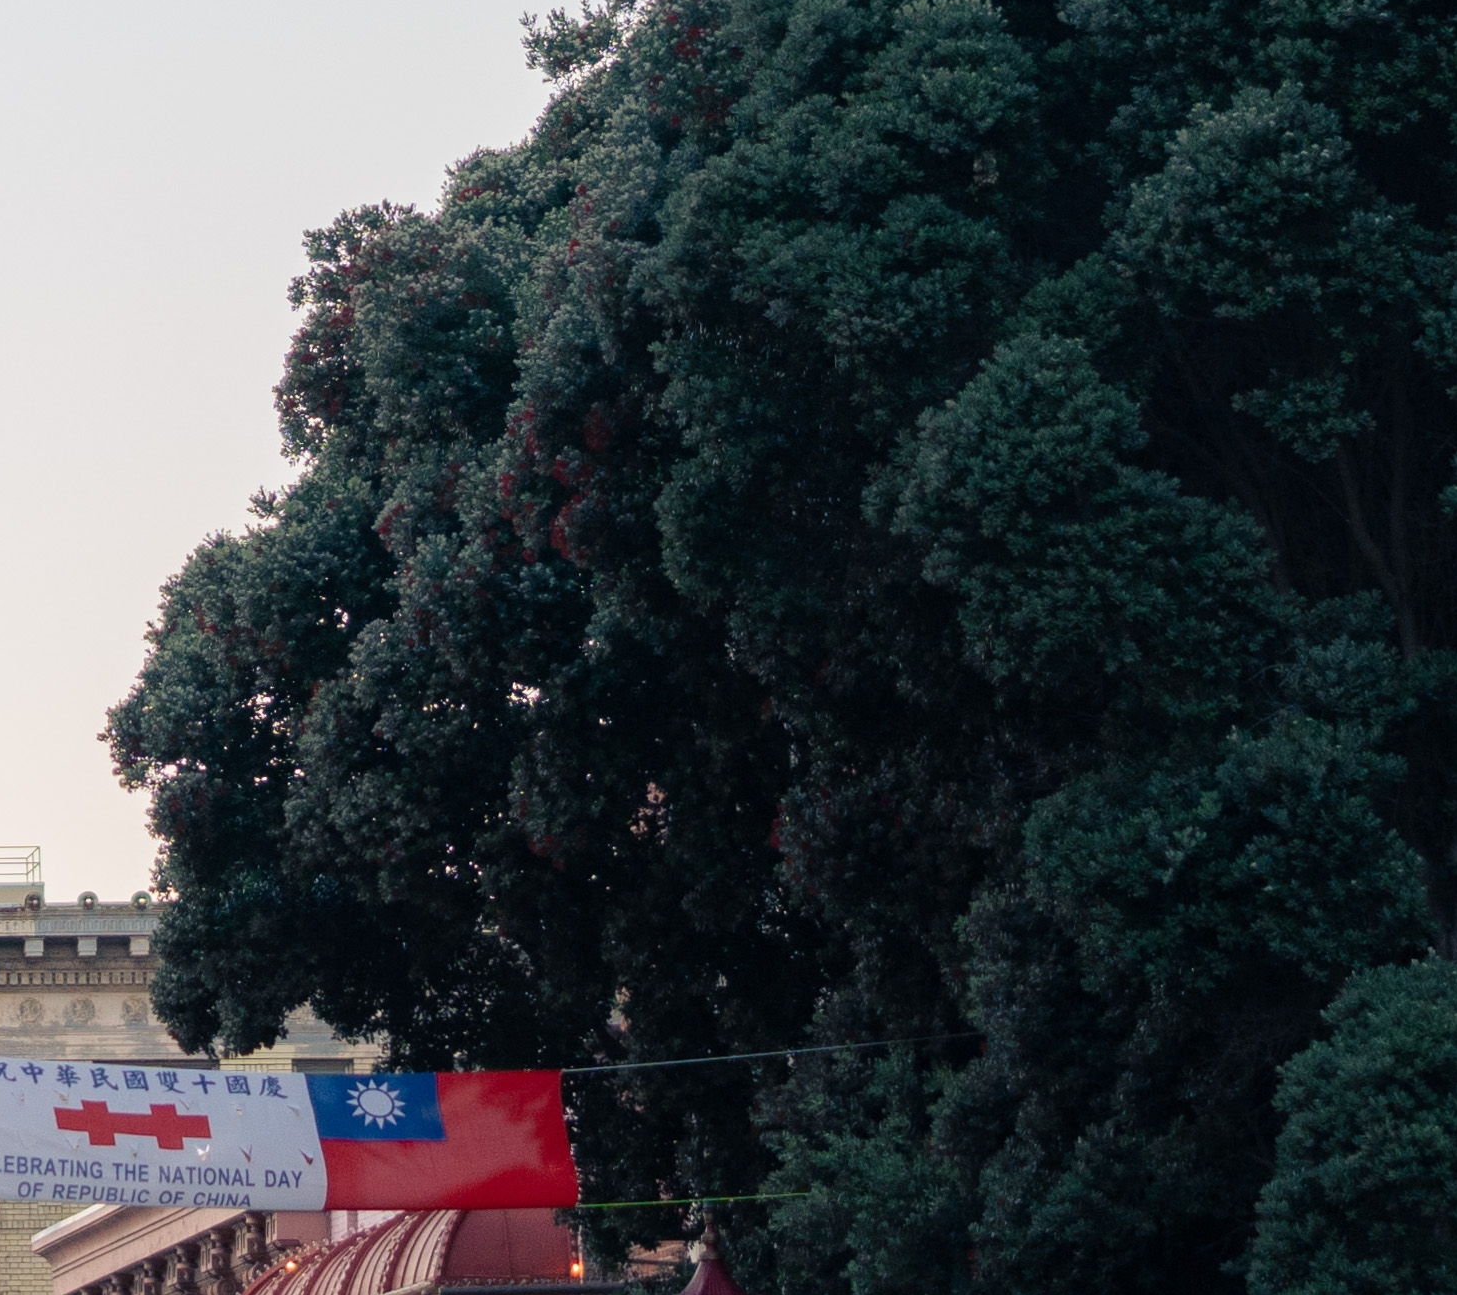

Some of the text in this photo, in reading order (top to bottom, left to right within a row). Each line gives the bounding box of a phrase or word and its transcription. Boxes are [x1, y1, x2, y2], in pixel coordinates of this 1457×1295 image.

[113, 1163, 149, 1183] THE
[158, 1165, 256, 1188] NATIONAL
[264, 1168, 303, 1189] DAY
[17, 1180, 252, 1207] OF REPUBLIC OF CHINA
